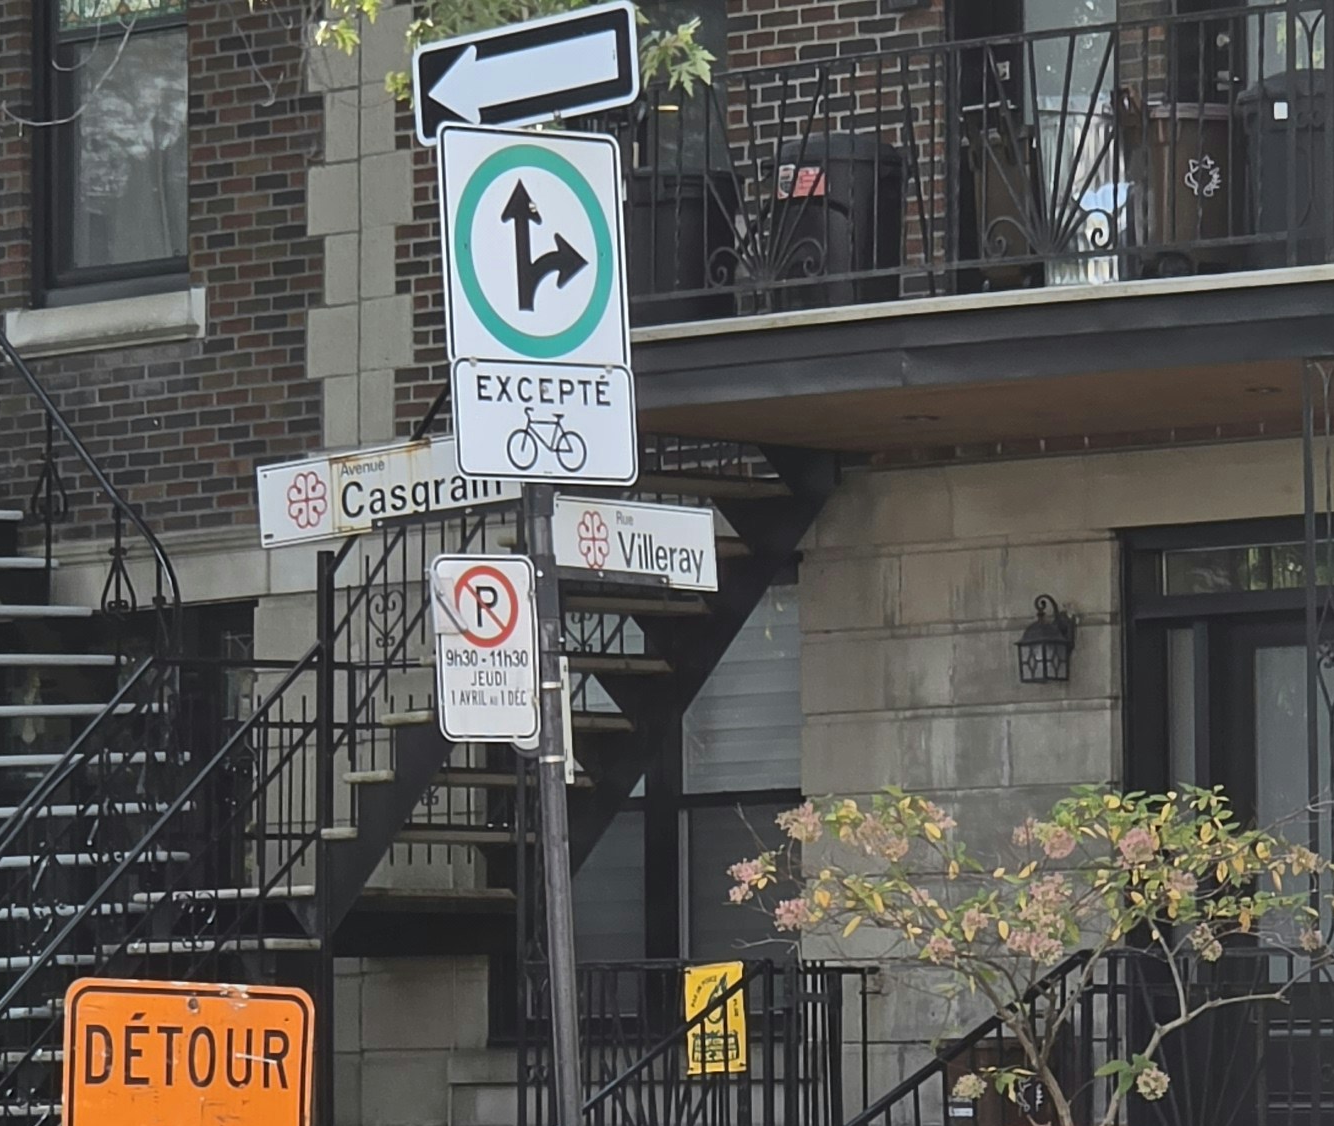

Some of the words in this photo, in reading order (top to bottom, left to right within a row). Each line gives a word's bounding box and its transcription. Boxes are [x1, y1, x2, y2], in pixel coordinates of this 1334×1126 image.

[477, 374, 612, 407] EXCEPTÉ
[340, 460, 385, 478] Avenue
[616, 511, 635, 528] Rue
[617, 532, 705, 583] Villeray
[446, 649, 478, 667] 9h30
[490, 650, 528, 667] 11h30
[471, 671, 507, 687] JEUDI
[459, 690, 487, 706] AVRIL
[508, 686, 527, 706] DÉC
[84, 1012, 291, 1089] DÉTOUR
